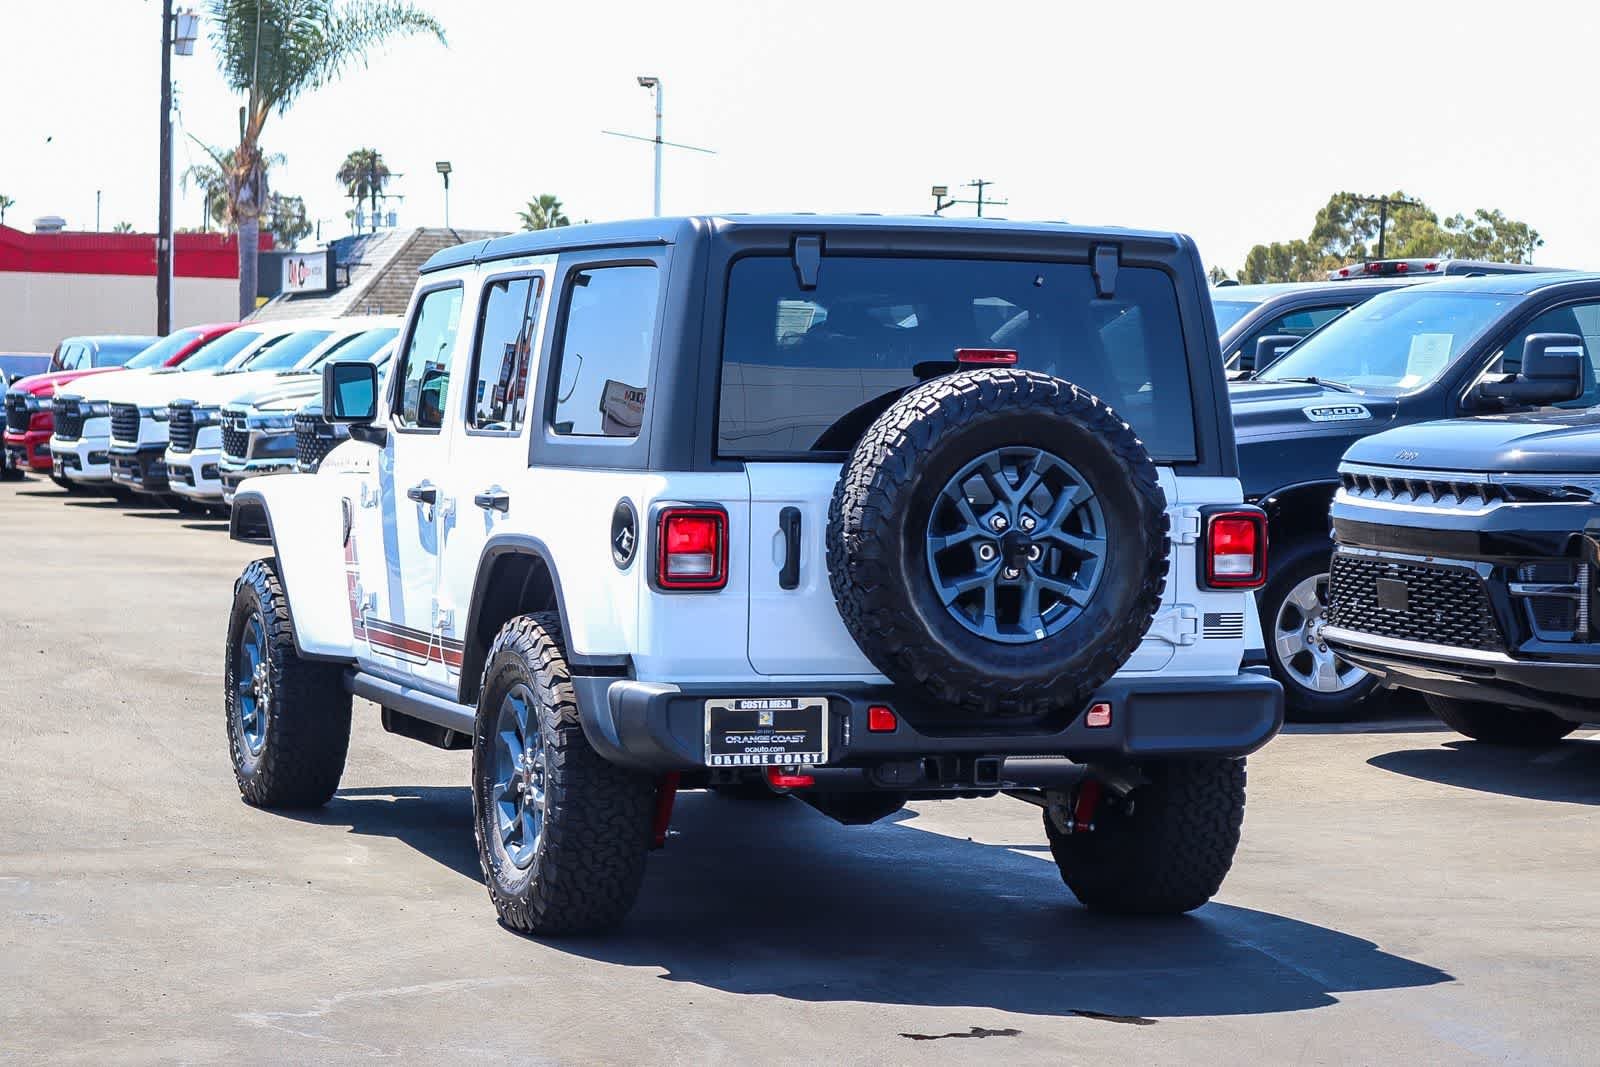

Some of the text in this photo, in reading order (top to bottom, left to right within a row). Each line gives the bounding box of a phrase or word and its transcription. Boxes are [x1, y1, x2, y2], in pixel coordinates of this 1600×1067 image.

[741, 700, 792, 709] COSTA MESA
[725, 735, 806, 743] ORANGE COAST
[714, 753, 820, 765] ORANGE COAST
